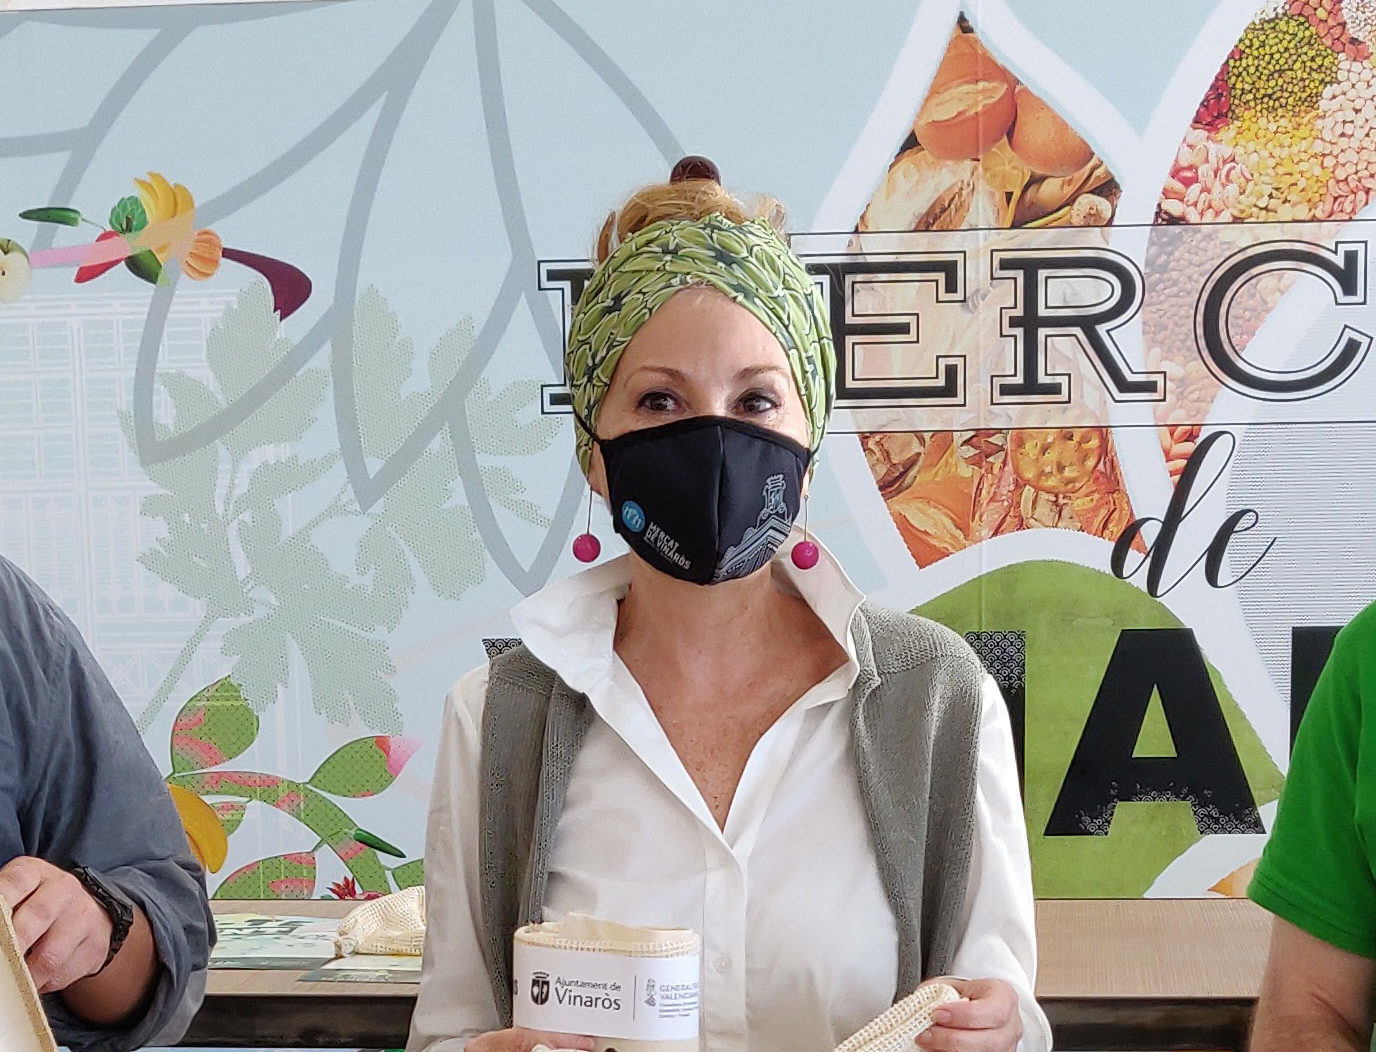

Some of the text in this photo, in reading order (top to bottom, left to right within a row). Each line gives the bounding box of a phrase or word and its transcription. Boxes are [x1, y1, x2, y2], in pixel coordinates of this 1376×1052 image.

[1110, 430, 1277, 598] de
[555, 976, 621, 992] Ajuntament de
[555, 987, 621, 1011] Vinaròs
